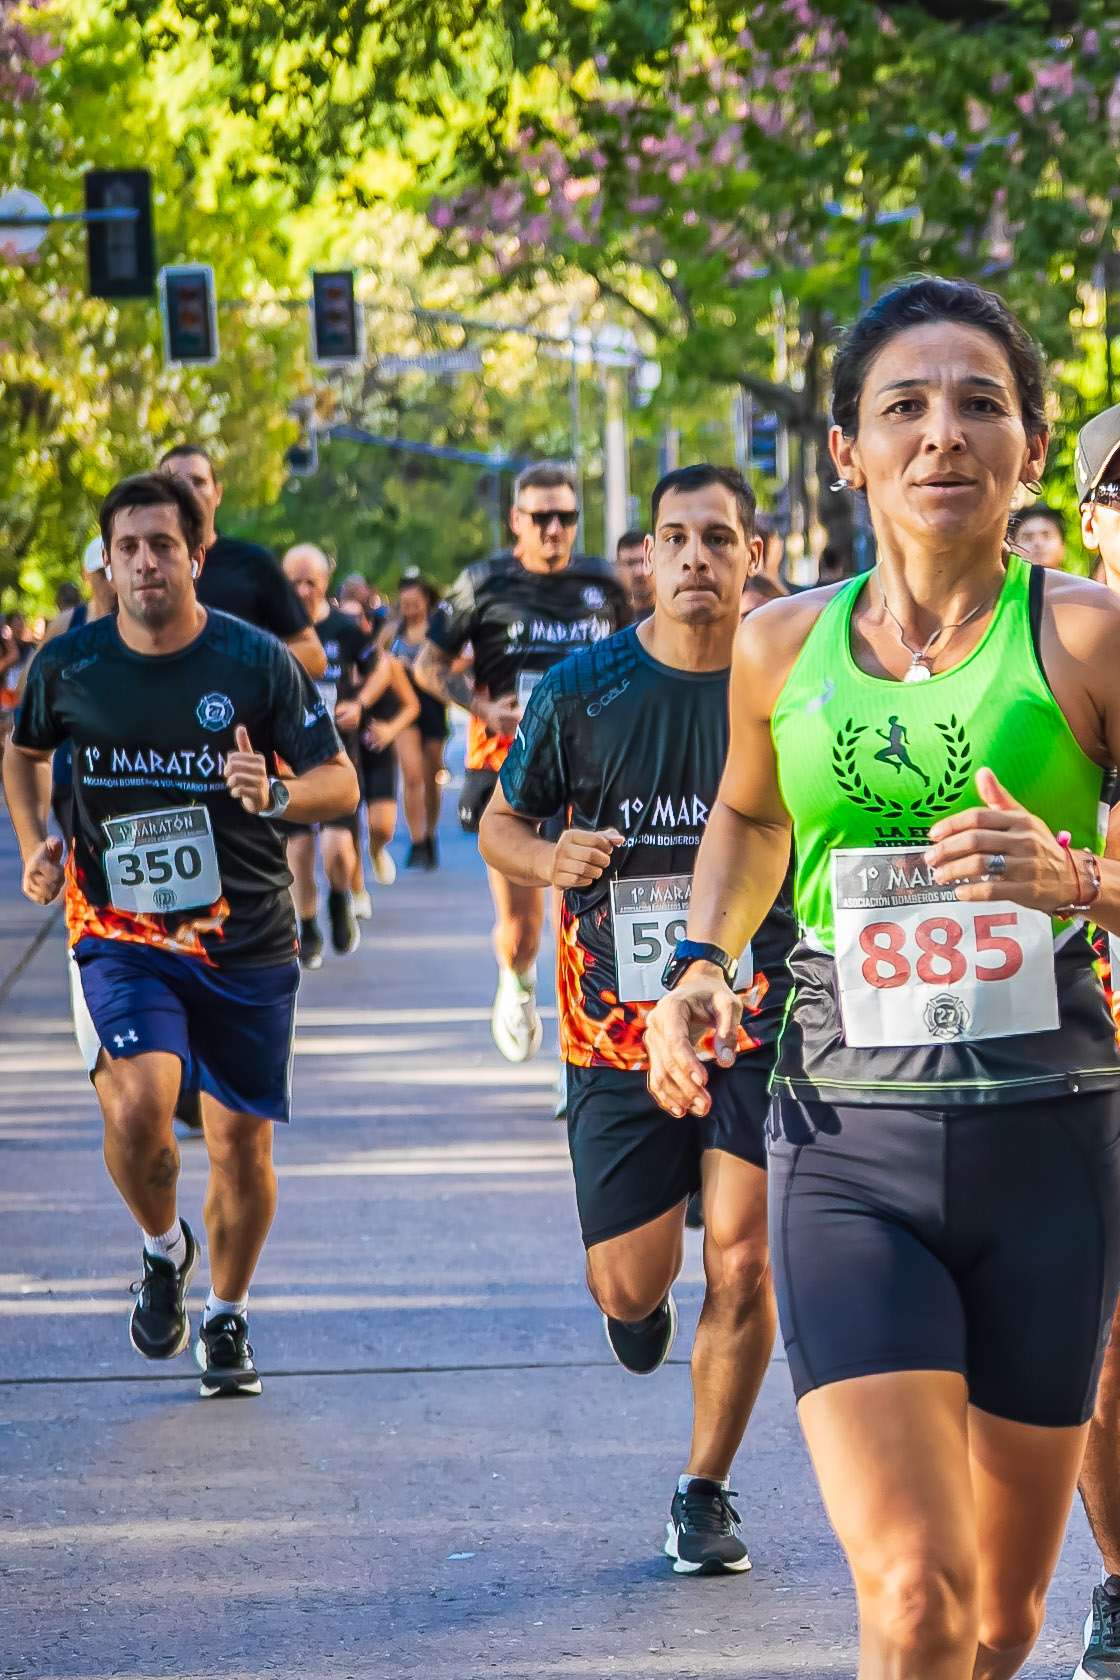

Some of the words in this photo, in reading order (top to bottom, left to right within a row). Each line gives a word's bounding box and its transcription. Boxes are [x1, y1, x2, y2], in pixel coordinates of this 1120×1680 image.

[875, 826, 905, 838] LA
[117, 845, 202, 887] 350
[859, 912, 1024, 990] 885
